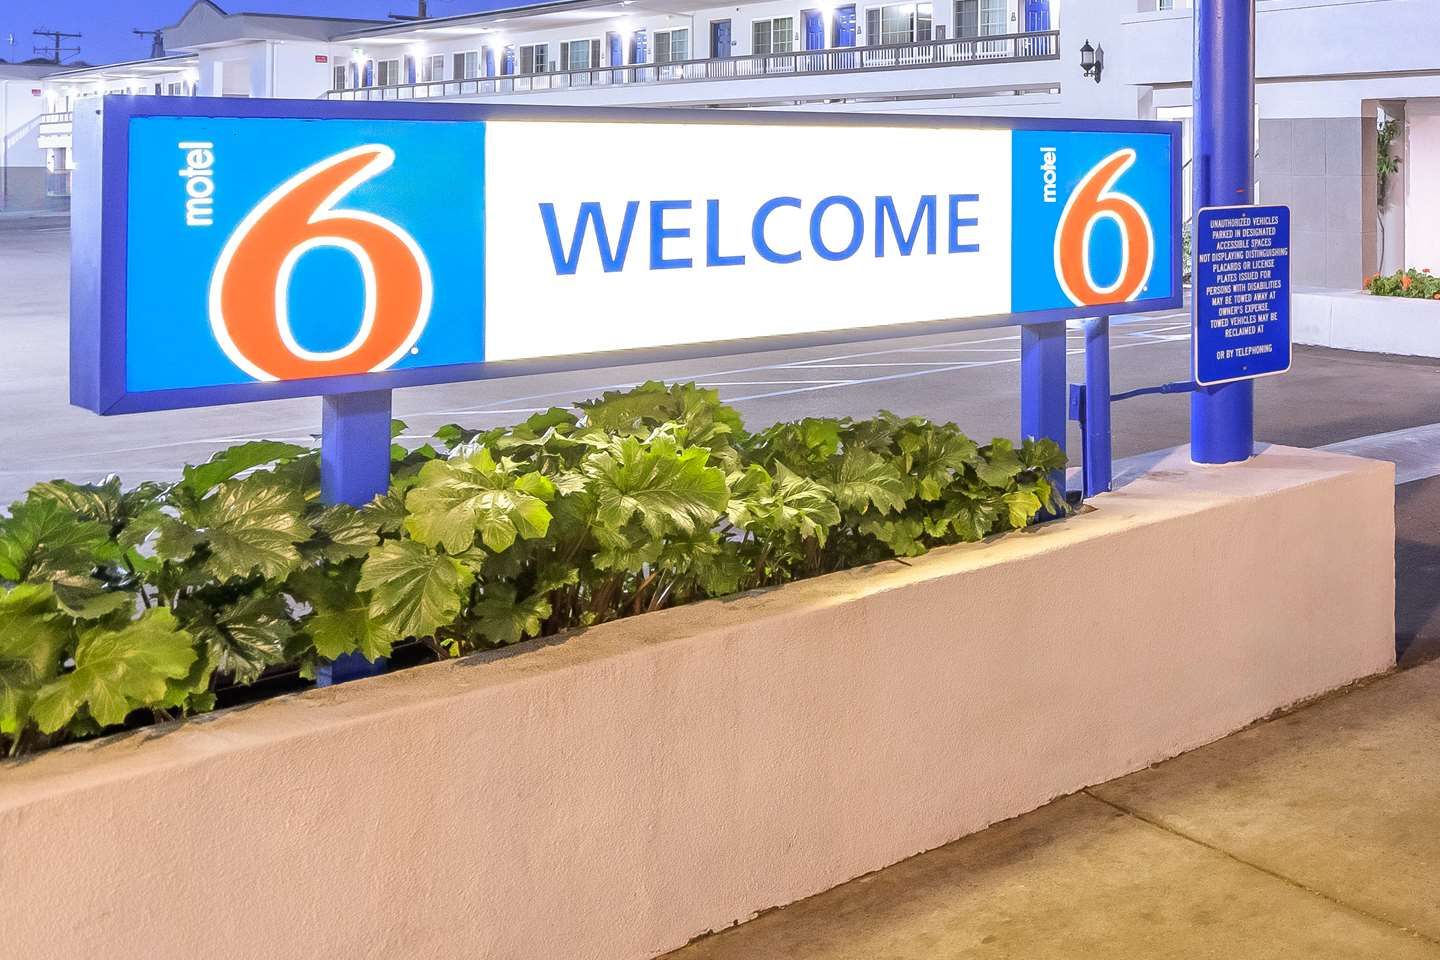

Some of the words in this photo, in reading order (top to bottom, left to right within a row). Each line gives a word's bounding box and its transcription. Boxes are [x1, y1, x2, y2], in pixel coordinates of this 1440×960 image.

[1040, 147, 1057, 203] motel
[1053, 148, 1154, 308] 6
[1210, 218, 1251, 228] UNAUTHORIZED
[1253, 216, 1279, 225] VEHICLES
[538, 194, 980, 276] WELCOME
[1212, 230, 1233, 239] PARKED
[1243, 227, 1276, 237] DESIGNATED
[1216, 240, 1250, 250] ACCESSIBLE
[1251, 239, 1272, 247] SPACES
[178, 141, 214, 226] motel
[208, 143, 433, 383] 6
[1200, 254, 1210, 262] NOT
[1212, 251, 1244, 261] DISPLAYING
[1246, 248, 1288, 258] DISTINGUISHING
[1213, 263, 1241, 272] PLACARDS
[1243, 261, 1251, 269] OR
[1252, 259, 1275, 268] LICENSE
[1217, 274, 1237, 283] PLATES
[1239, 272, 1259, 280] ISSUED
[1206, 285, 1231, 295] PERSONS
[1233, 284, 1246, 292] WITH
[1248, 280, 1281, 290] DISABILITIES
[1212, 297, 1223, 306] MAY
[1225, 296, 1232, 304] BE
[1234, 294, 1252, 303] TOWED
[1254, 292, 1269, 300] AWAY
[1270, 291, 1276, 299] AT
[1219, 306, 1243, 316] OWNER'S
[1210, 319, 1229, 328] TOWED
[1231, 315, 1256, 325] VEHICLES
[1270, 312, 1278, 320] BE
[1225, 326, 1256, 337] RECLAIMED
[1258, 325, 1264, 333] AT
[1216, 351, 1225, 360] OR
[1226, 350, 1234, 358] BY
[1235, 344, 1273, 356] TELEPHONING
